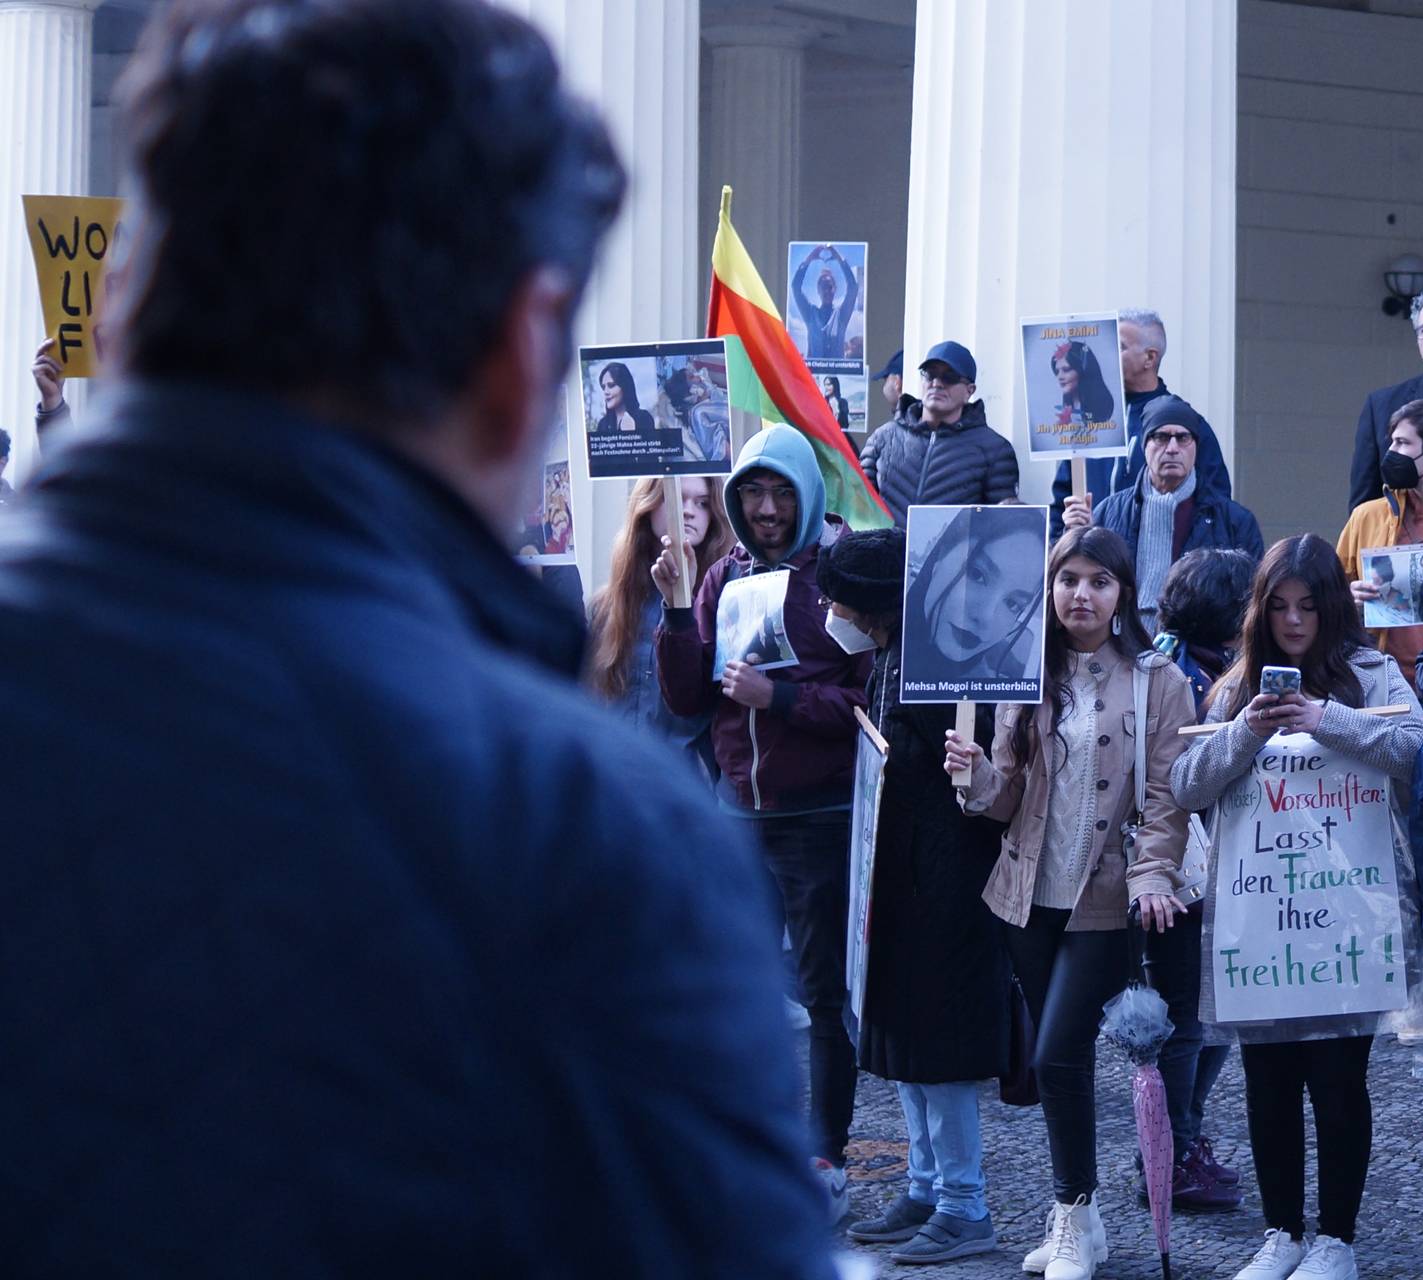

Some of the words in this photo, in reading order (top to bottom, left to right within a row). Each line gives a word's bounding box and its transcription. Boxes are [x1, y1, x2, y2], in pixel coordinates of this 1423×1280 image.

[904, 681, 937, 691] Mehsa
[970, 681, 983, 691] ist
[984, 681, 1038, 691] unsterblich
[1249, 745, 1327, 776] eine
[1264, 772, 1386, 822] Vorschriften:
[1255, 816, 1338, 853] Lasst
[1232, 859, 1279, 896] den
[1278, 853, 1392, 894] Frauen
[1278, 898, 1337, 931] ihre
[1219, 936, 1365, 988] Freiheit
